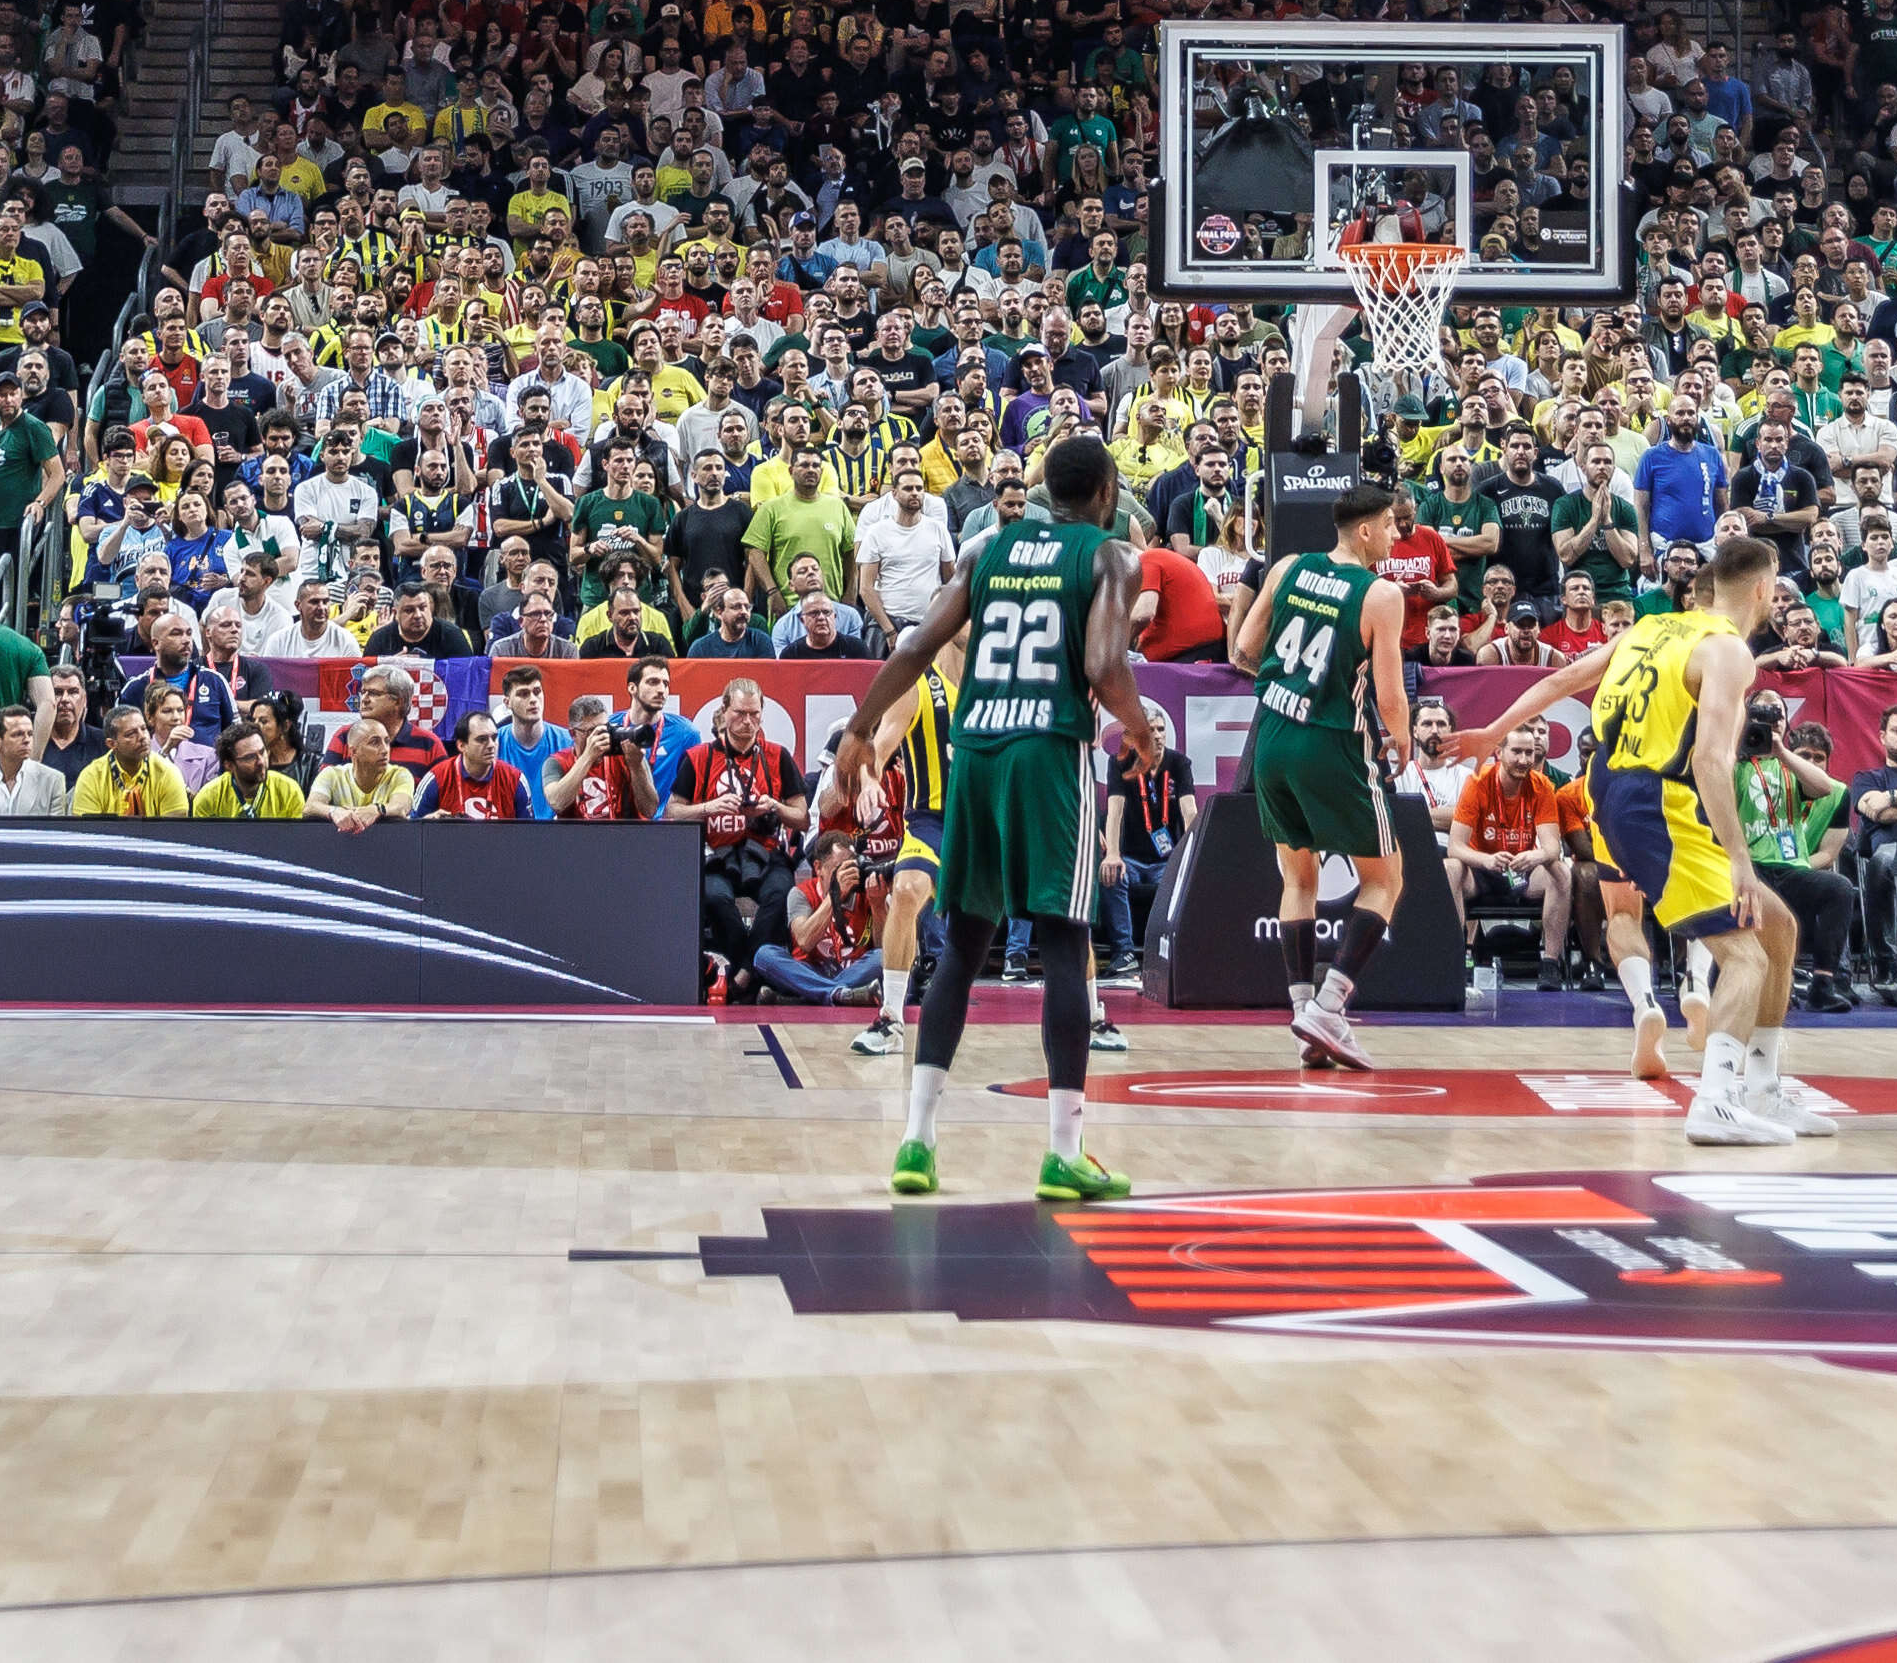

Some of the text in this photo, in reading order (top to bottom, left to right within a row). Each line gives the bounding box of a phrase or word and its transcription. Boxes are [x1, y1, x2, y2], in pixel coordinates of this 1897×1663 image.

[589, 180, 624, 198] 1903
[1282, 473, 1353, 491] SPALDING
[1500, 494, 1550, 519] BUCKS
[1008, 540, 1064, 567] GRANT
[1286, 593, 1340, 619] more.com
[974, 598, 1062, 683] 22
[1274, 615, 1335, 685] 44
[962, 698, 1054, 731] ATHENS
